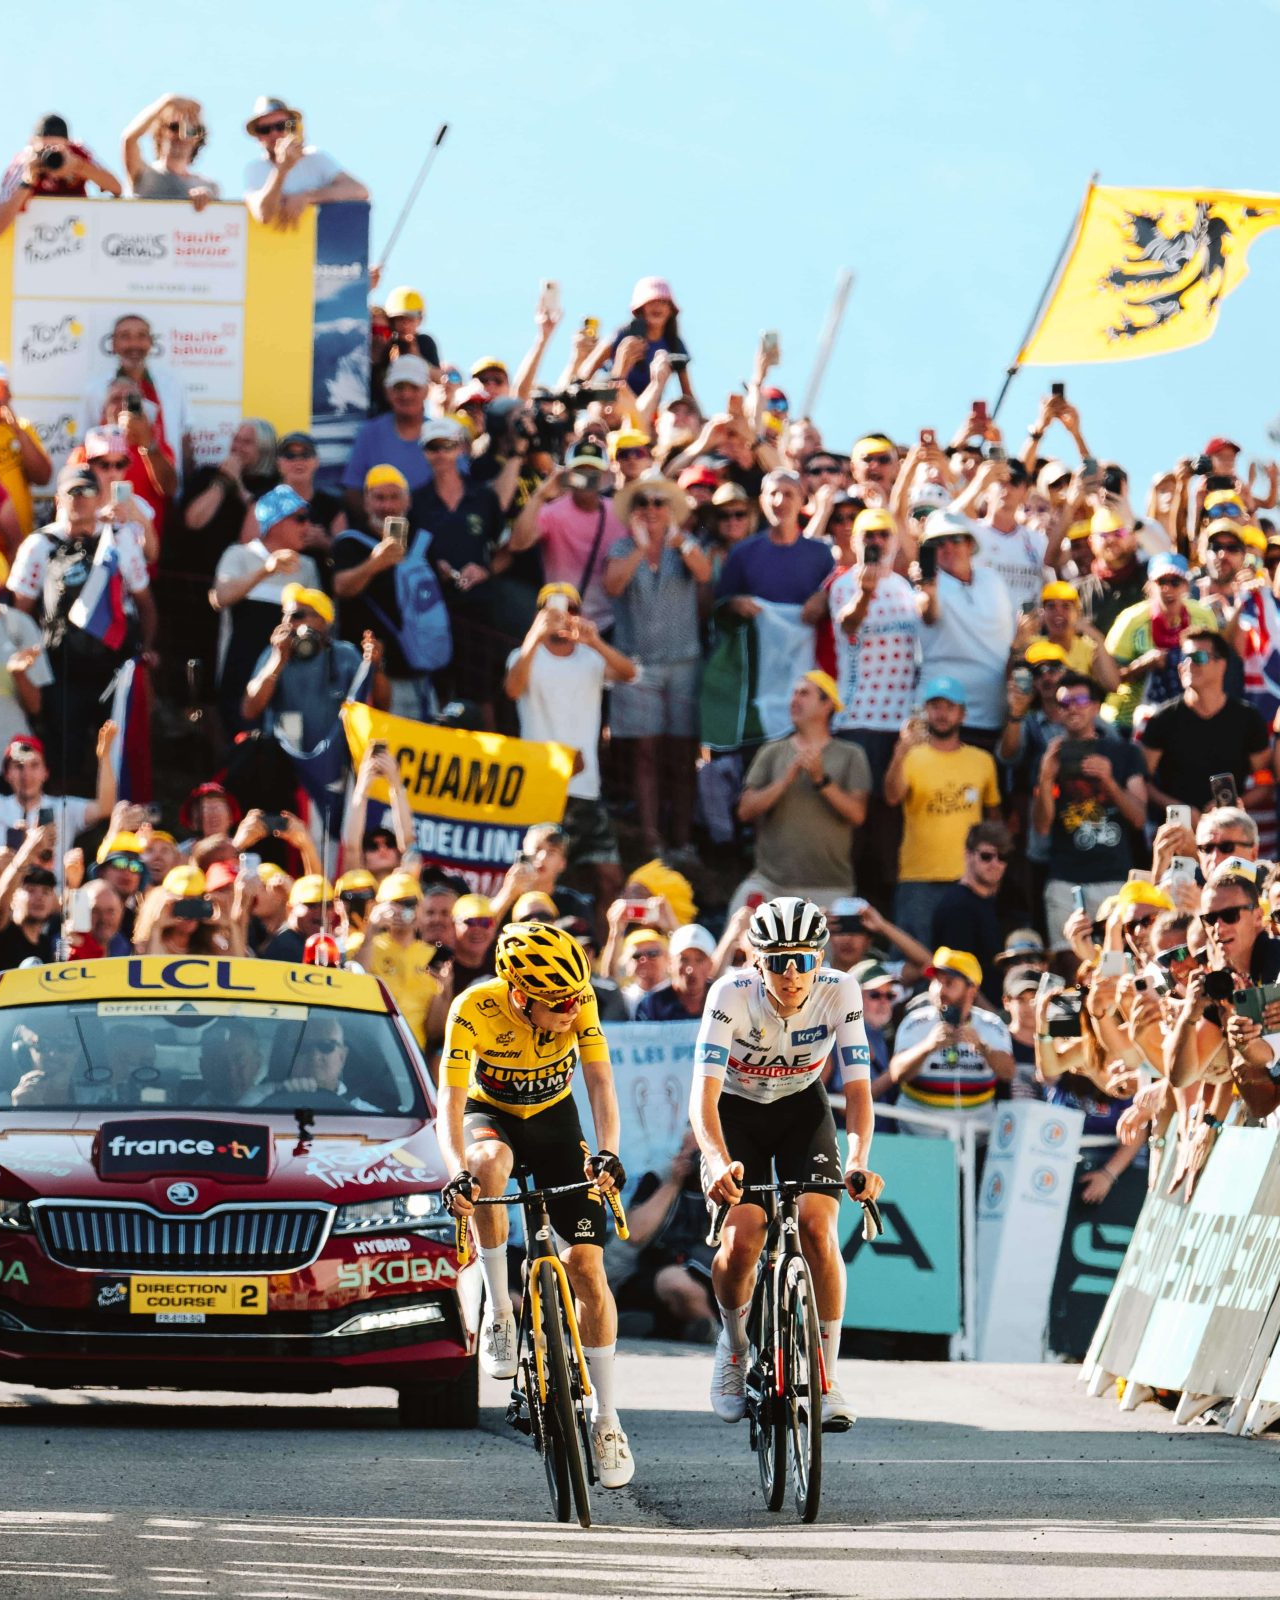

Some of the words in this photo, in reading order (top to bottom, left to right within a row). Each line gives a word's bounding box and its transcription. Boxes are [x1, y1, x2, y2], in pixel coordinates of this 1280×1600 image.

[45, 966, 96, 982] LCL
[128, 959, 256, 991] LCL
[290, 970, 343, 987] LCL
[818, 975, 840, 985] Krys
[733, 978, 753, 988] Krys
[103, 1004, 169, 1013] OFFICIEL
[797, 1028, 823, 1043] Krys
[742, 1052, 812, 1067] UAE
[481, 1056, 574, 1082] JUMBO
[736, 1064, 810, 1077] Emirates
[353, 1237, 412, 1255] HYBRID
[136, 1283, 227, 1294] DIRECTION
[146, 1297, 216, 1308] COURSE
[240, 1285, 259, 1308] 2
